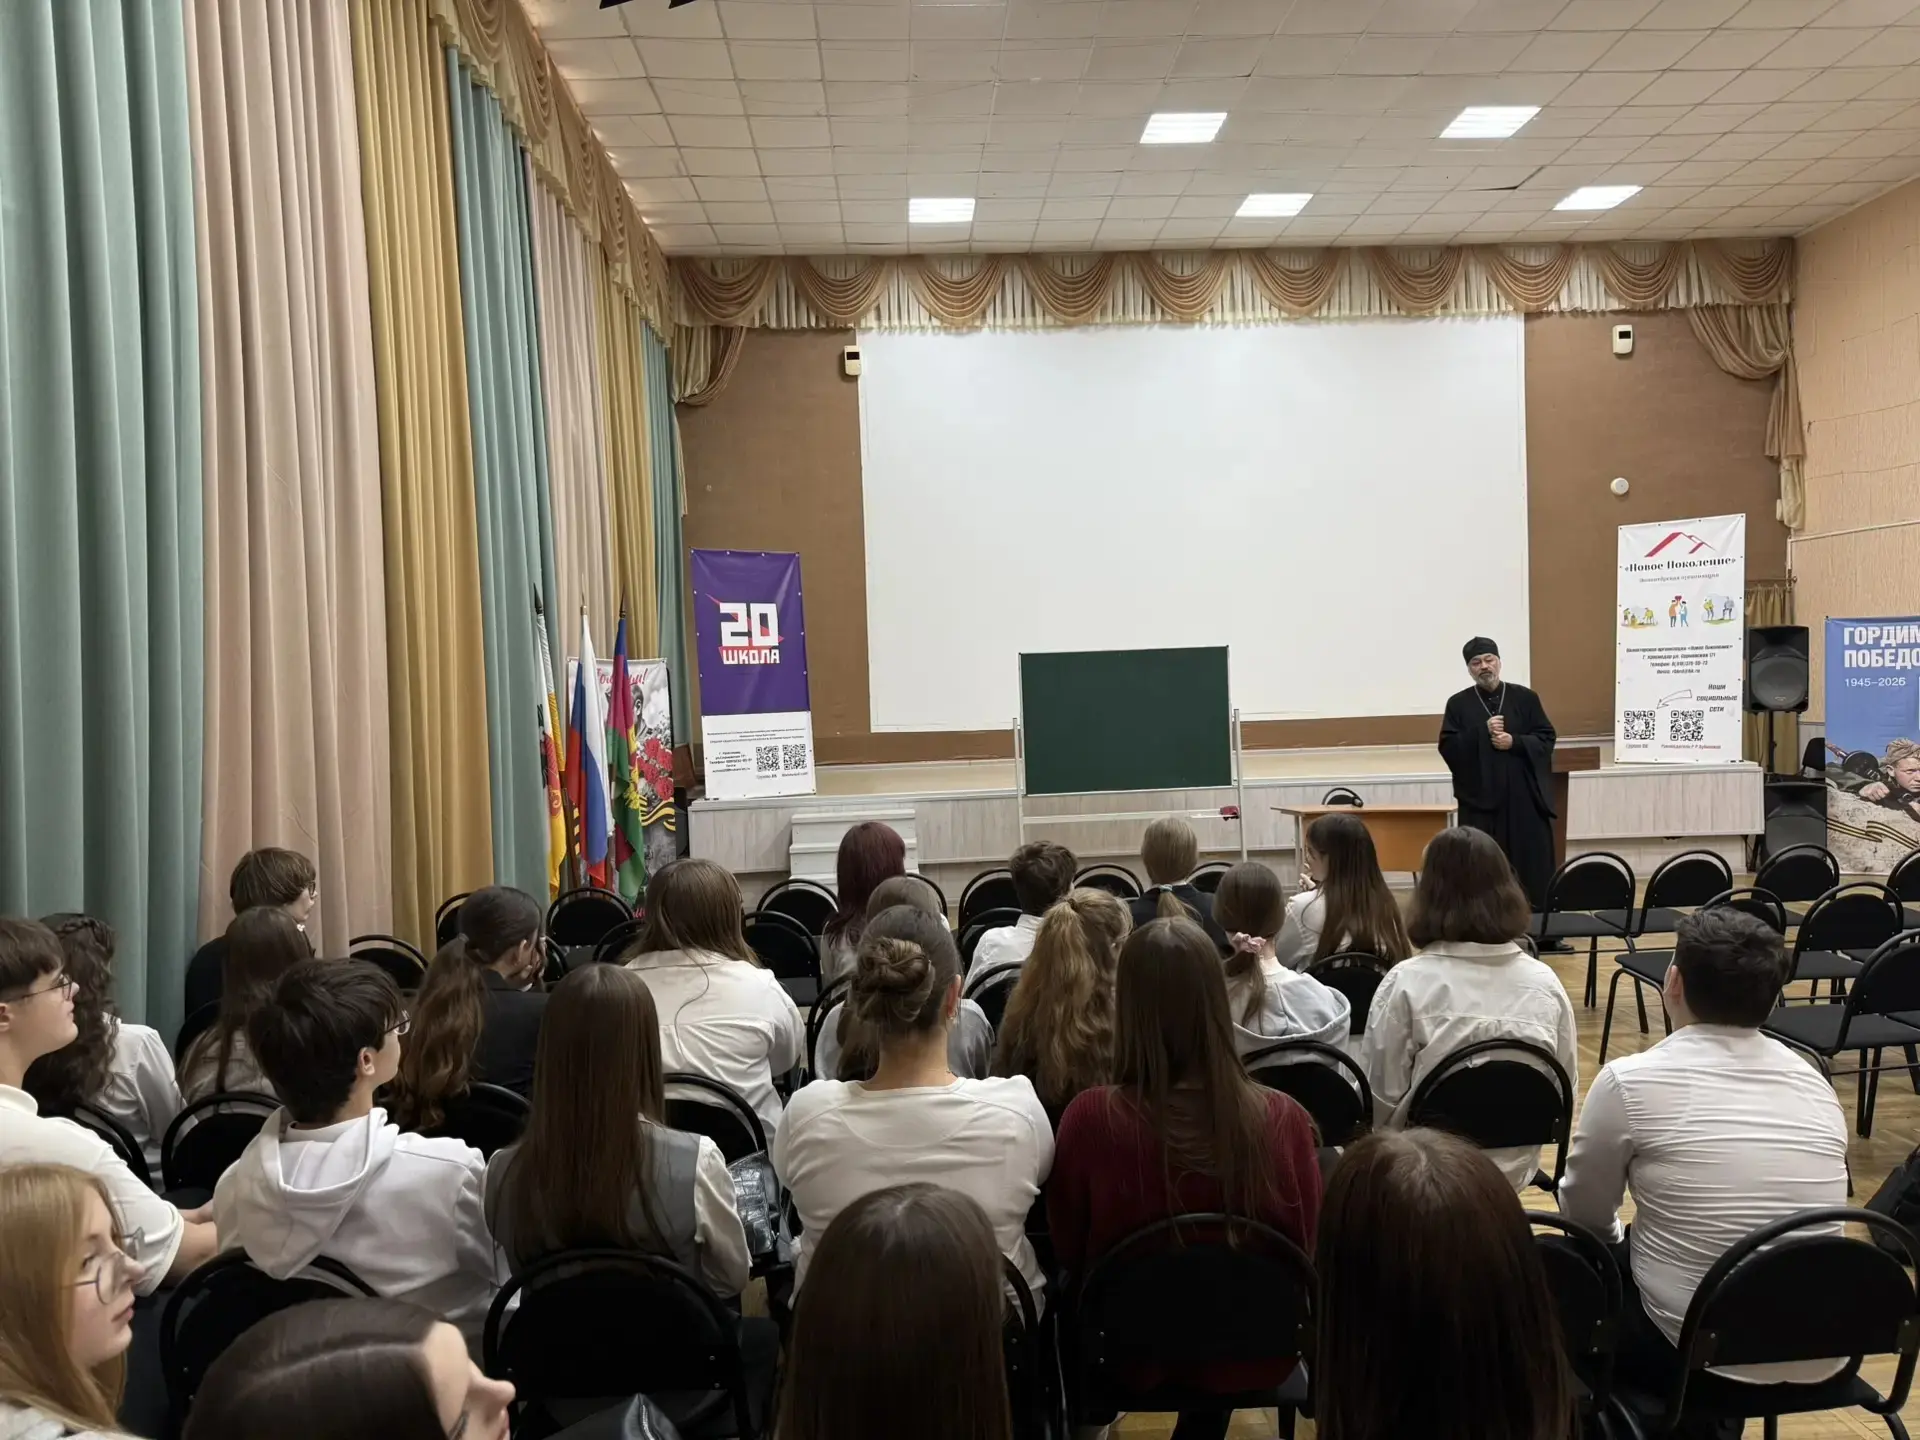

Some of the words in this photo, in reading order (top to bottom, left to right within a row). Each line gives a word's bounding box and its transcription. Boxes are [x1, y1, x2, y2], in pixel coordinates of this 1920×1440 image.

[719, 602, 779, 647] 20
[722, 649, 780, 665] ШКОЛА
[1843, 648, 1920, 670] ПОБЕДО
